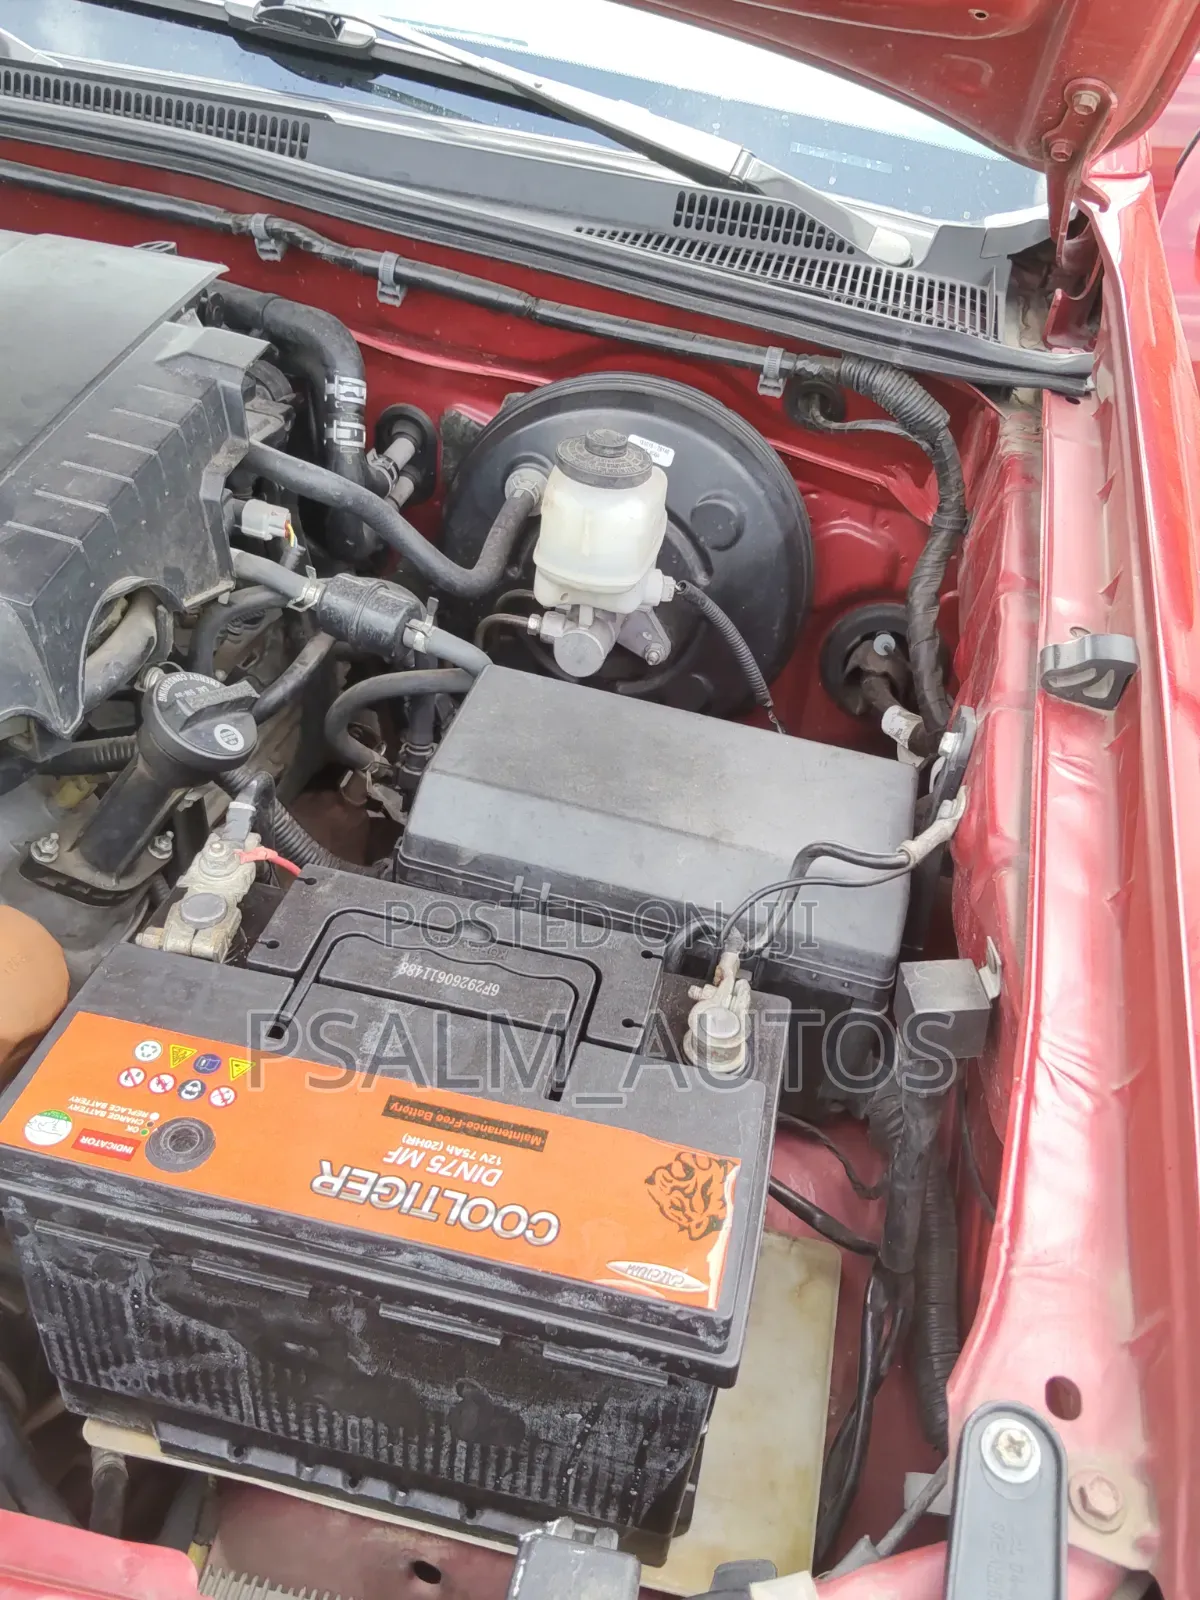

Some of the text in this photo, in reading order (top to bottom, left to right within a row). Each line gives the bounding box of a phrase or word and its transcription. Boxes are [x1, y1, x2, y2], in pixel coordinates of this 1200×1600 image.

[158, 673, 221, 702] ENERGY CONSERVING
[68, 1096, 150, 1117] REPLACE BATTERY
[68, 1104, 107, 1117] BATTERY
[108, 1111, 144, 1125] CHARGE
[126, 1125, 140, 1133] OK
[389, 1102, 542, 1146] Maintenance-Free Battery
[80, 1136, 134, 1155] INDICATOR
[401, 1132, 503, 1165] 12V 75Ah (20HR)
[383, 1146, 503, 1188] DIN75 MF
[310, 1160, 560, 1246] COOLTIGER
[625, 1264, 685, 1288] CALCIUM
